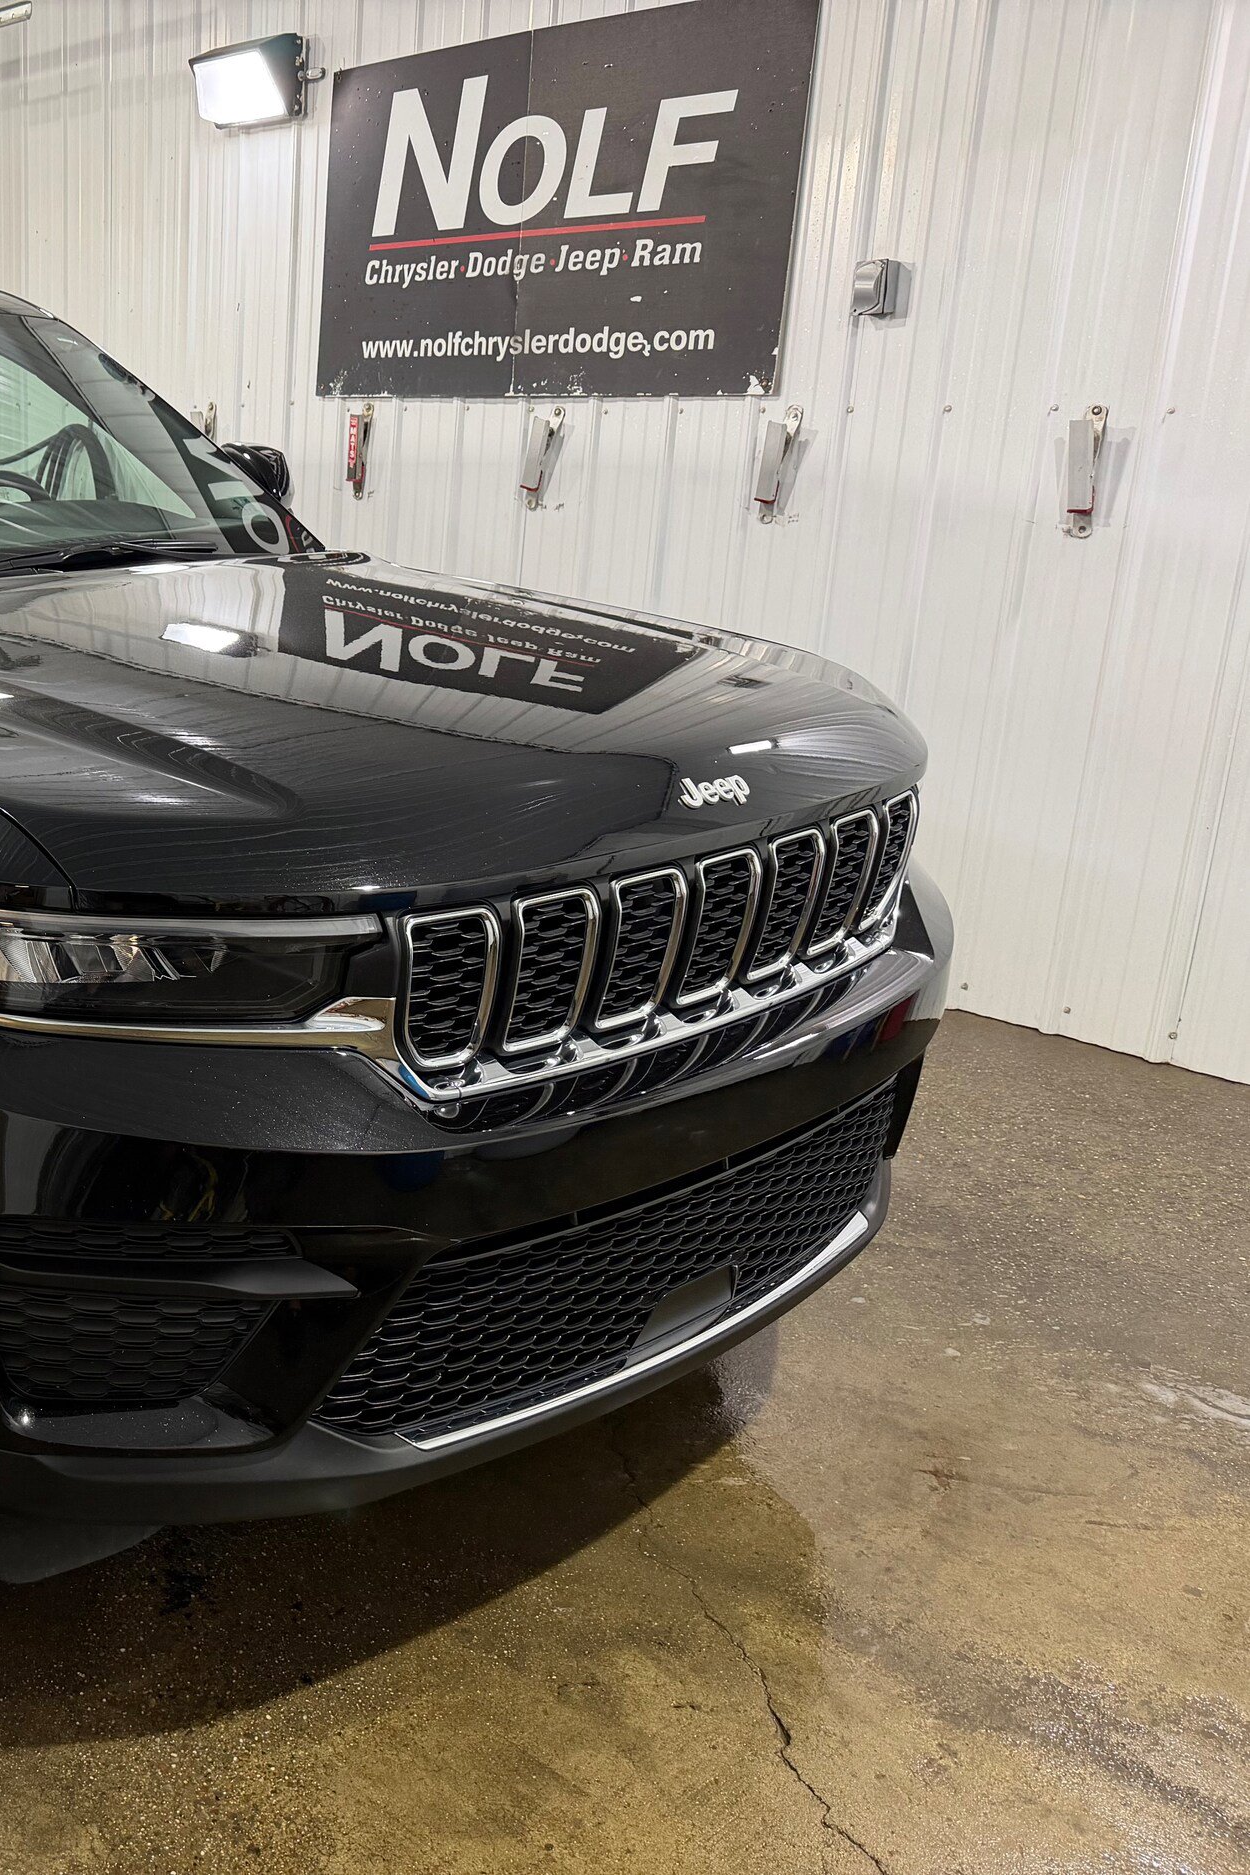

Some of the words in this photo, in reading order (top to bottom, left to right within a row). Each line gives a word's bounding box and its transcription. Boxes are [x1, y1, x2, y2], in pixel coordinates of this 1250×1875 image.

[371, 75, 739, 238] NOLF
[364, 255, 459, 288] Chrysler
[465, 249, 546, 281] Dodge
[554, 244, 621, 276] Jeep
[630, 238, 703, 268] Ram
[361, 325, 716, 362] www.nolfchryslerdodge.com
[678, 774, 750, 808] Jeep
